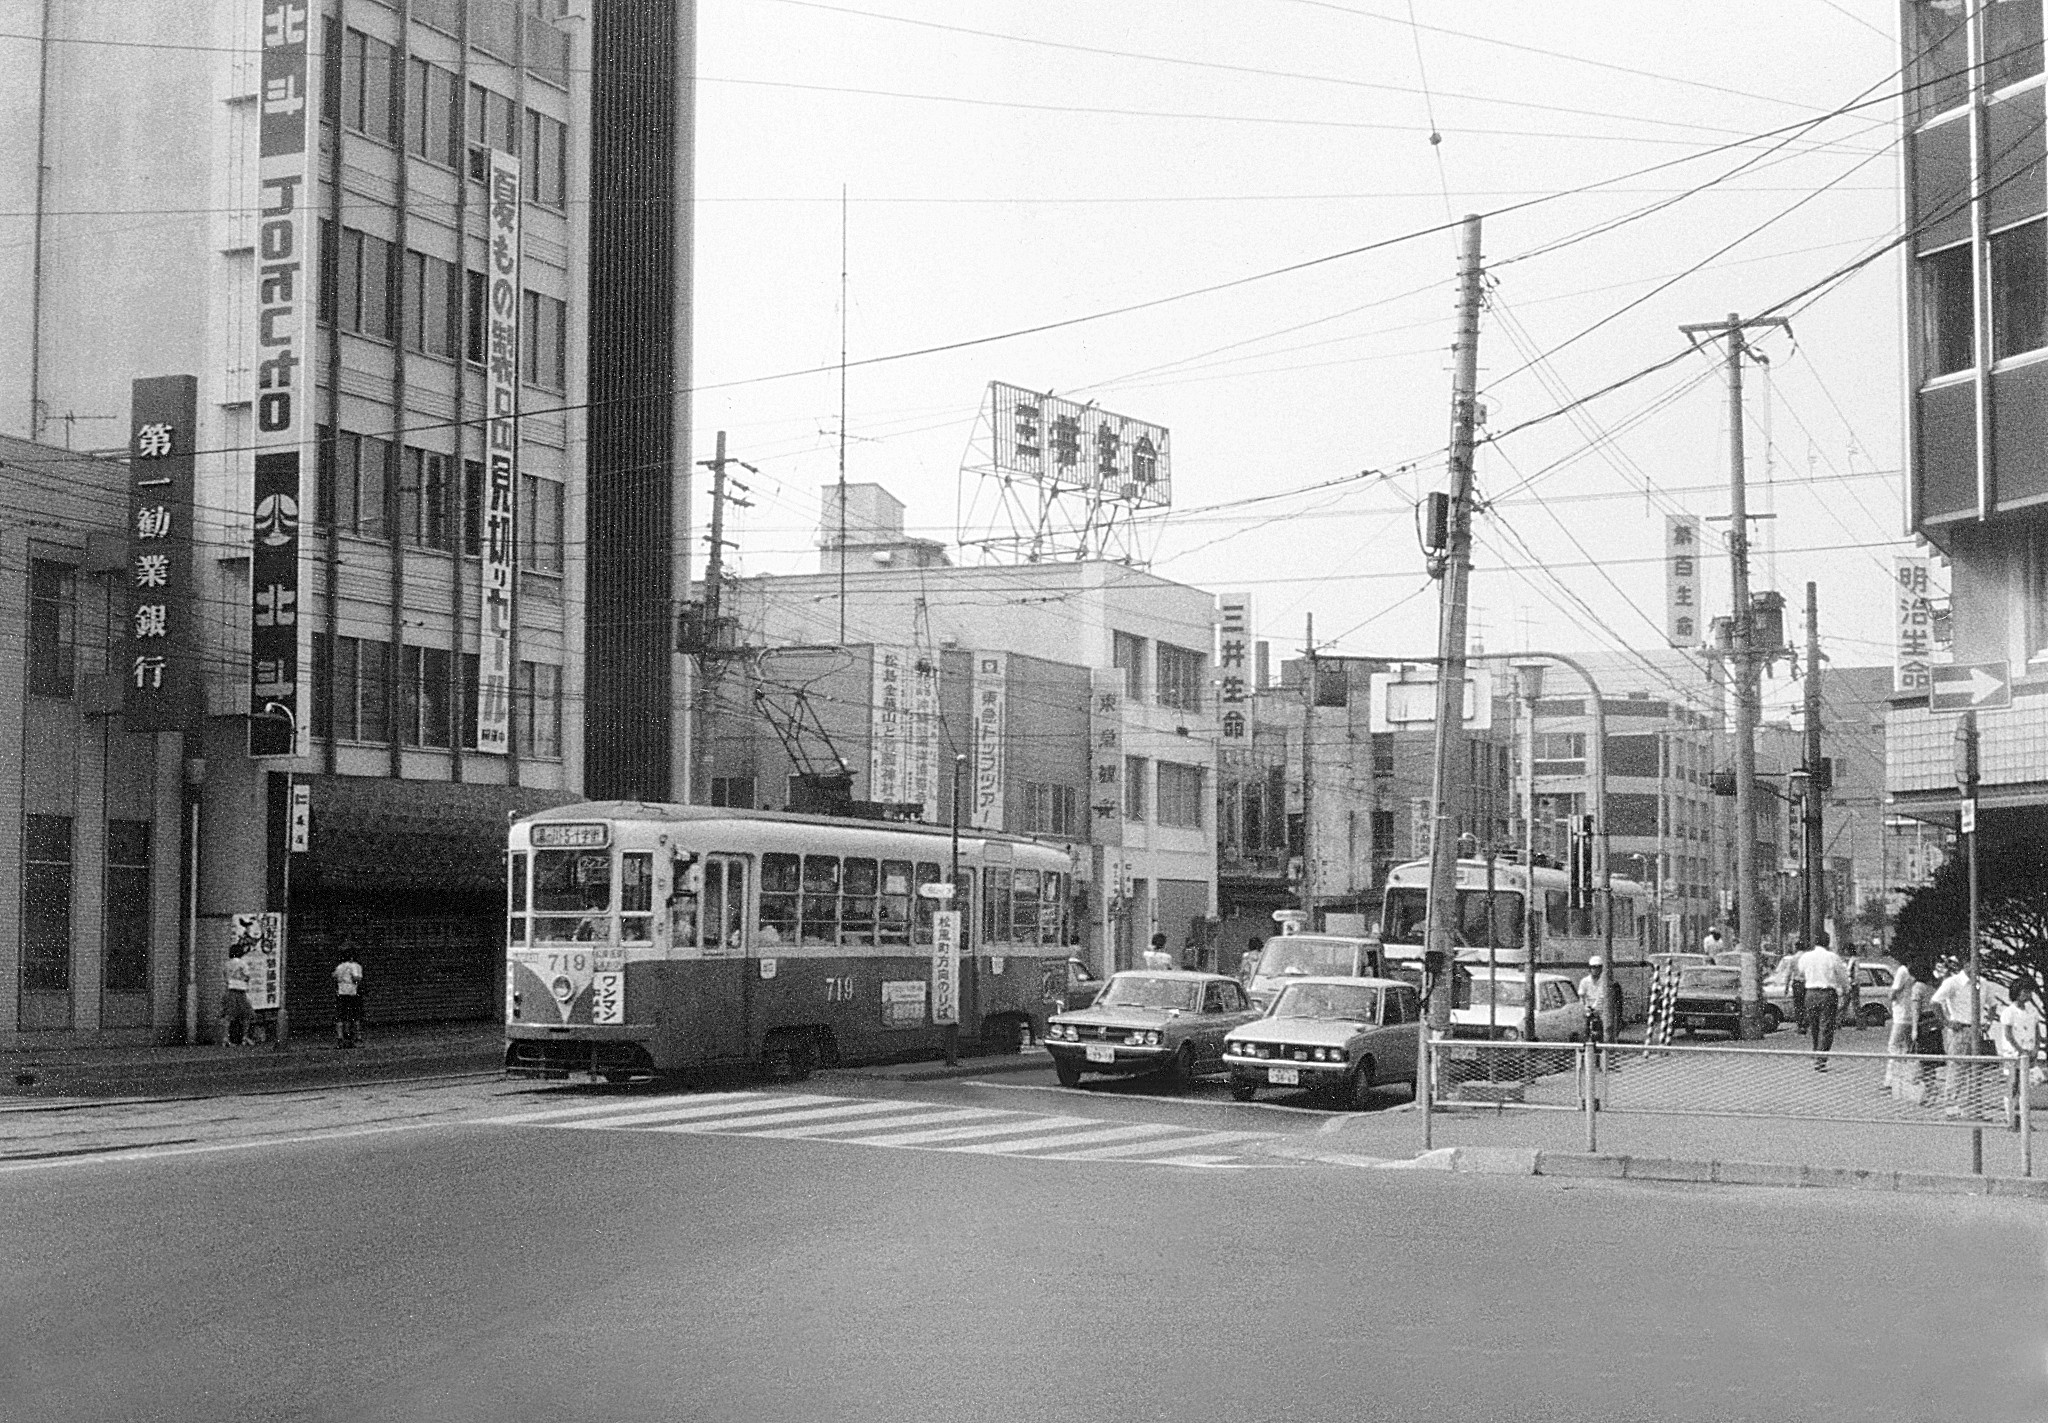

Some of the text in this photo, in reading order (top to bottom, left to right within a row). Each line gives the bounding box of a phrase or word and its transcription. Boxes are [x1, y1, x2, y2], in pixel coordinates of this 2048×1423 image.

[264, 4, 305, 115] 北斗
[259, 175, 301, 433] hokuto
[135, 423, 172, 688] 第一勧業銀行
[1674, 525, 1693, 636] 第百生命
[255, 584, 296, 699] 北斗
[1221, 605, 1246, 739] 三井生命
[1900, 565, 1930, 687] 明治生命
[548, 953, 586, 972] 719
[602, 975, 618, 1022] ワンマン
[826, 976, 853, 1001] 719
[938, 917, 954, 1021] 松風町方向のりば
